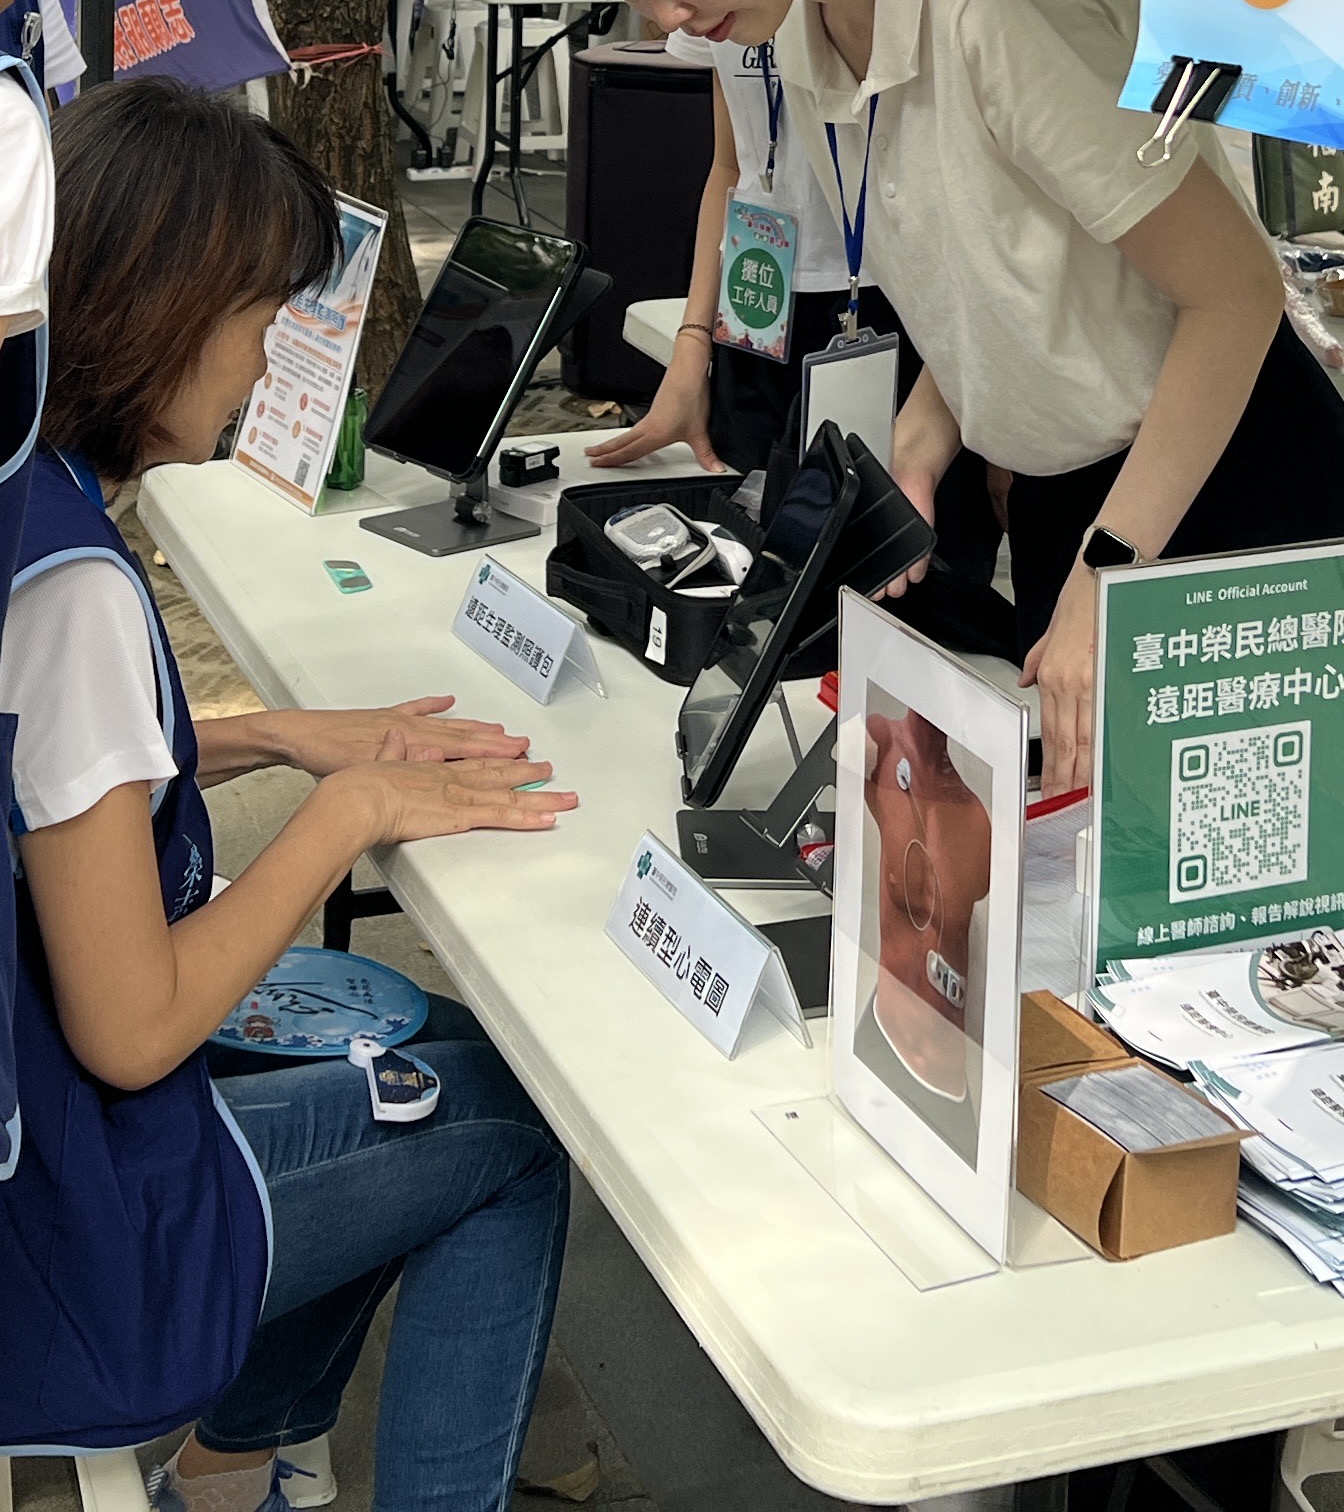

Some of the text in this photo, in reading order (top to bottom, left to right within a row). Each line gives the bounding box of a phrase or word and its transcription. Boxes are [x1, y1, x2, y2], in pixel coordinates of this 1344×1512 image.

[741, 258, 775, 289] 攤位
[731, 285, 778, 315] 工作人員
[1186, 578, 1308, 606] LINE Official Account
[1220, 800, 1261, 823] LINE
[629, 896, 730, 1017] 連續型心電圖
